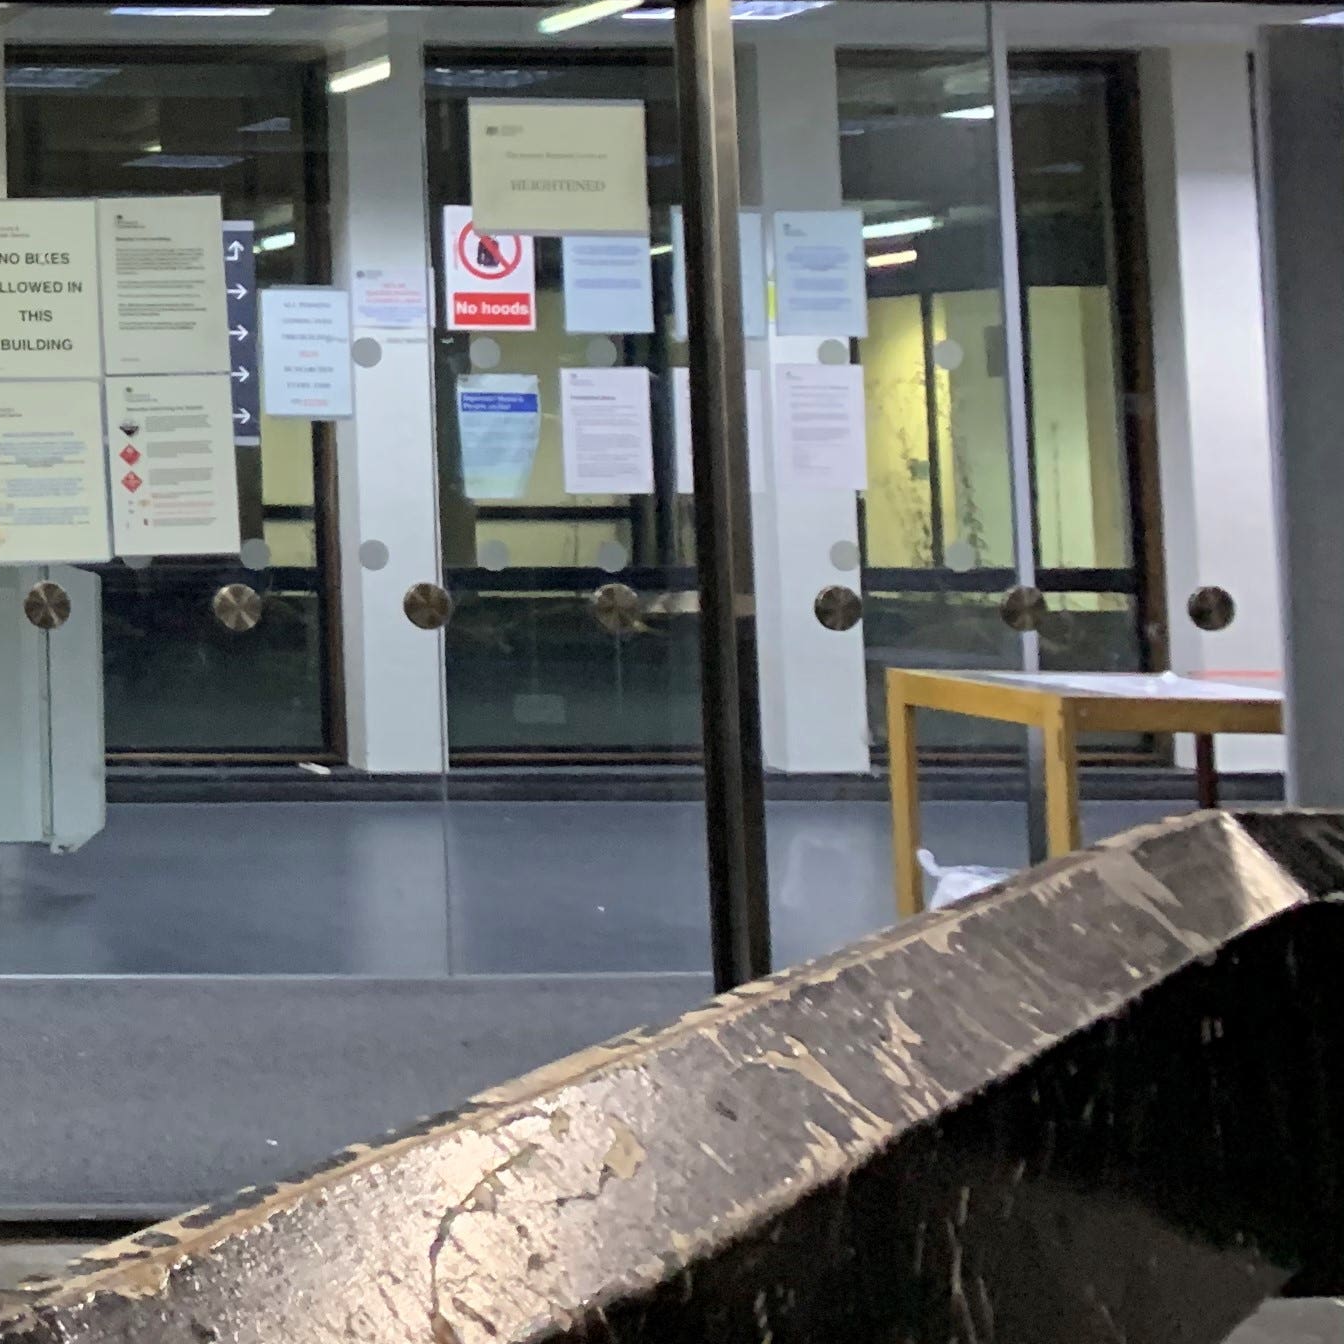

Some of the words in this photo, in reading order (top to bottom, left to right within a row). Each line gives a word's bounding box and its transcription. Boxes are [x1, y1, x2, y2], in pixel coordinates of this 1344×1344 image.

[67, 282, 83, 293] IN
[456, 301, 478, 315] No
[481, 301, 529, 315] hoods
[19, 310, 53, 322] THIS
[0, 338, 73, 351] BUILDING
